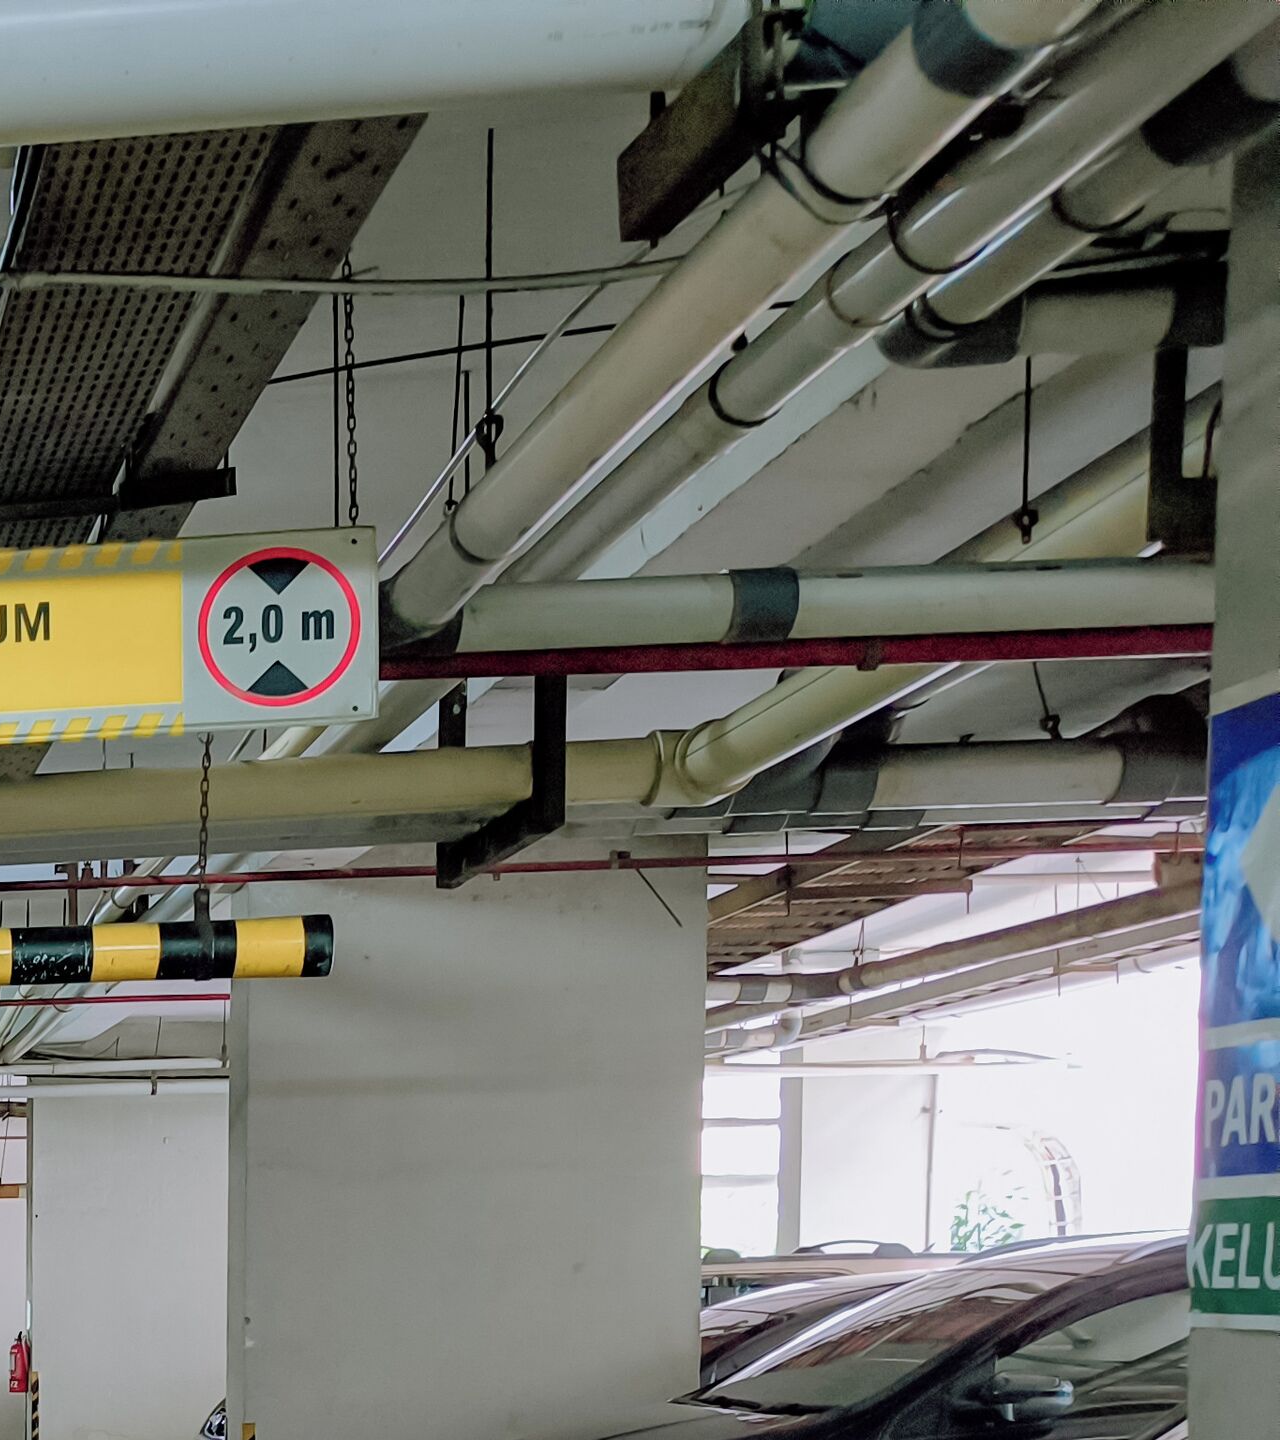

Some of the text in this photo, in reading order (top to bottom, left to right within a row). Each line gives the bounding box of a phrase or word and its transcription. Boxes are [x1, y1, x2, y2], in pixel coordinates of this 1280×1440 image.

[222, 604, 335, 653] 2,0 m
[1204, 1072, 1277, 1148] PAR
